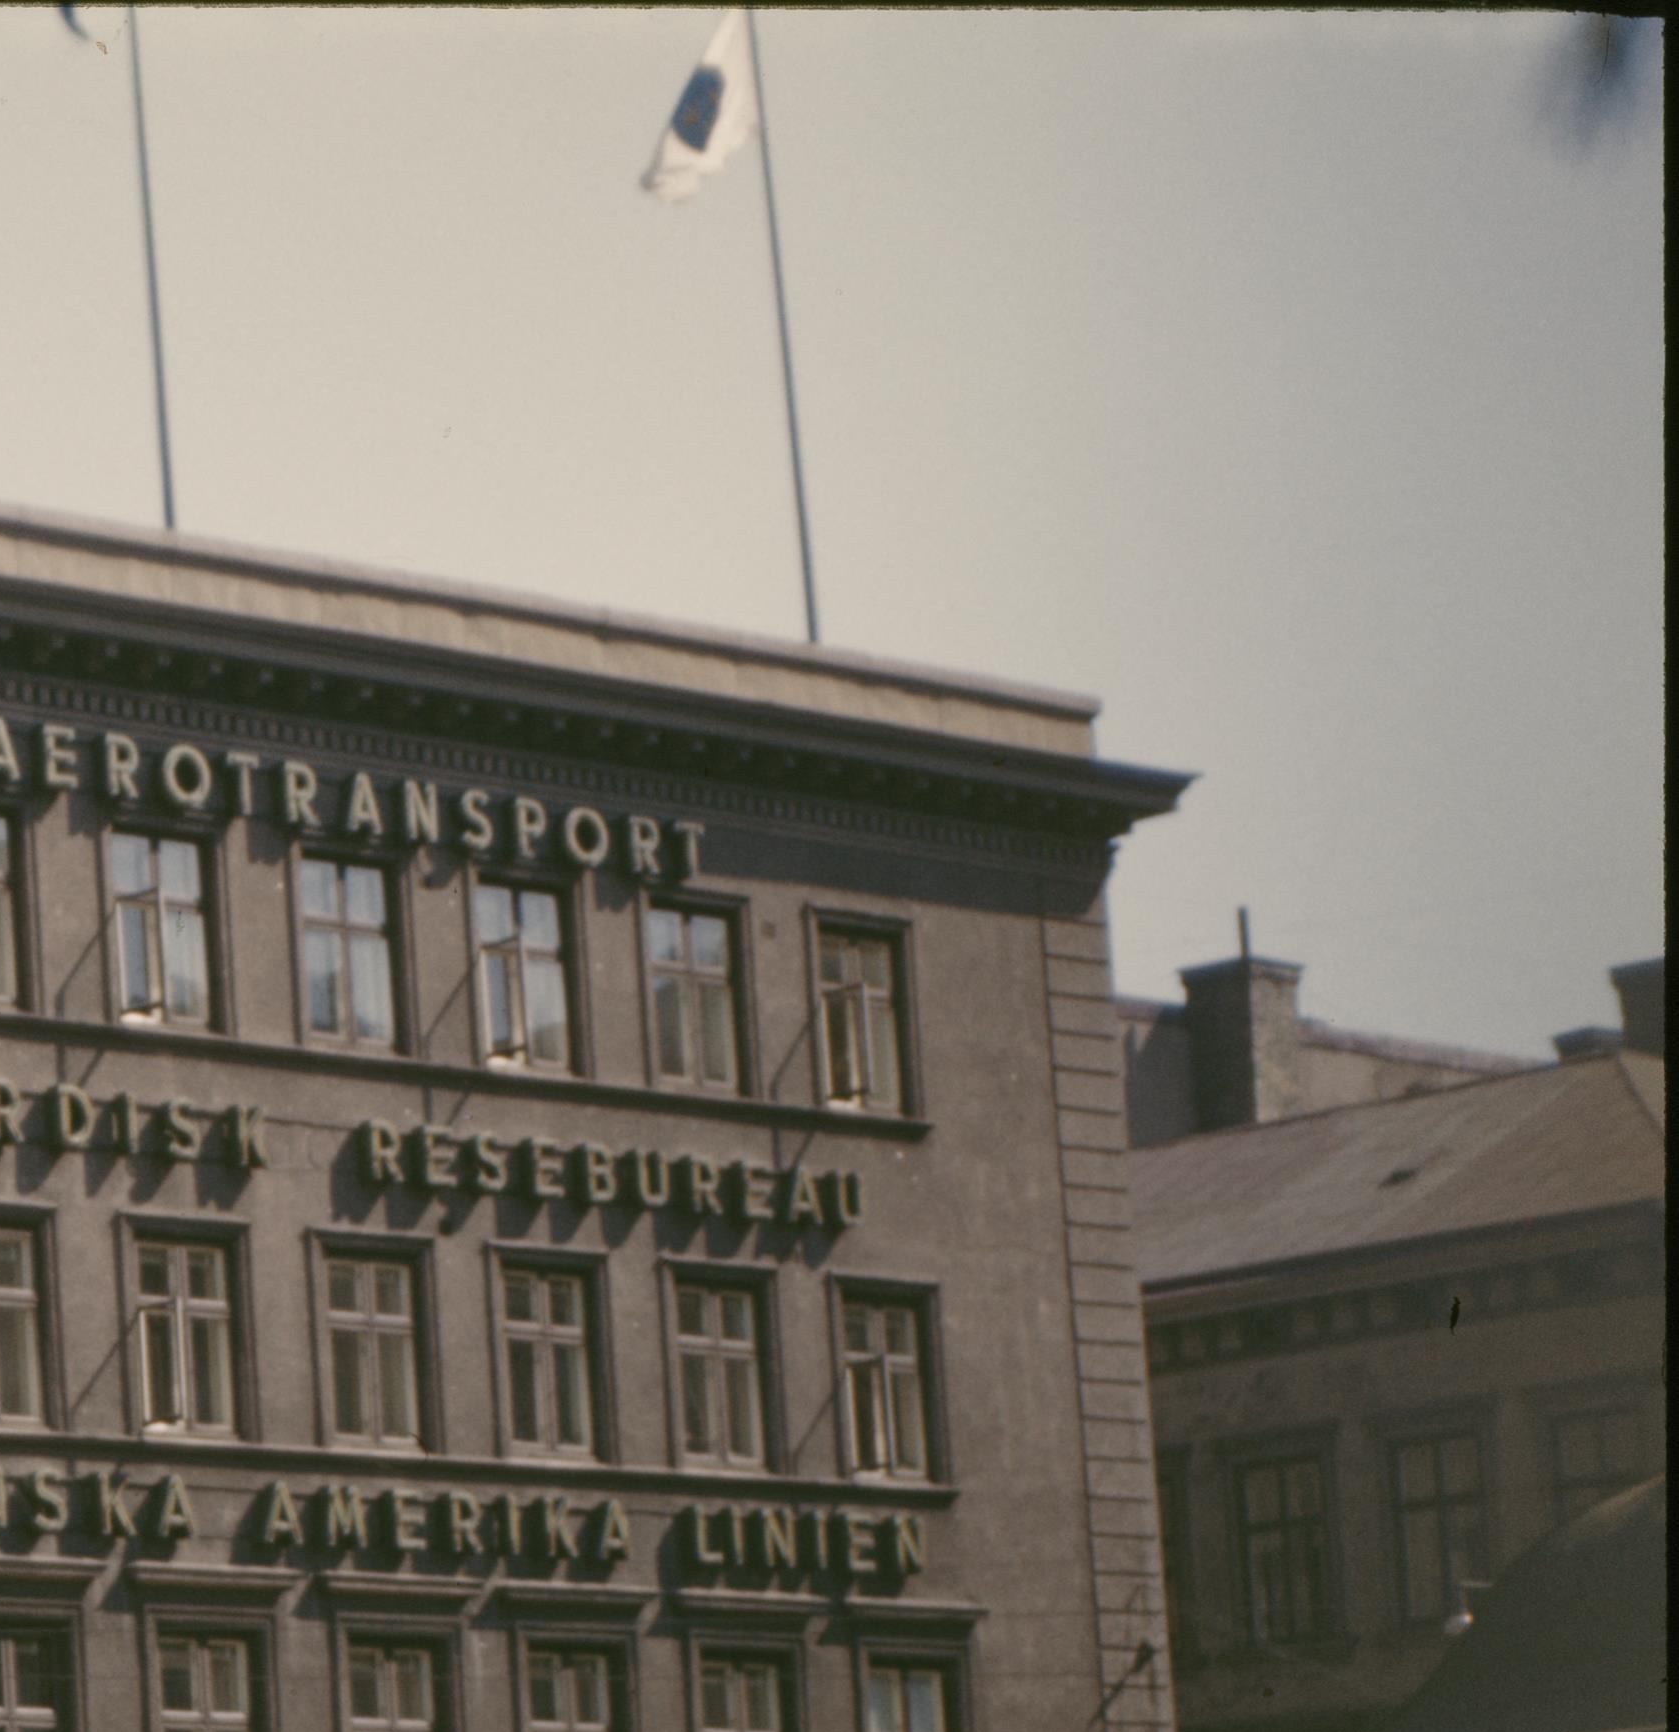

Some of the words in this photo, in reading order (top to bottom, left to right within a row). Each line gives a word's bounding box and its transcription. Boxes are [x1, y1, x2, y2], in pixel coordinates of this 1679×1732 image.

[368, 1118, 862, 1226] RESEBUREAU
[261, 1481, 632, 1563] AMERIKA
[691, 1504, 927, 1574] LINIEN
